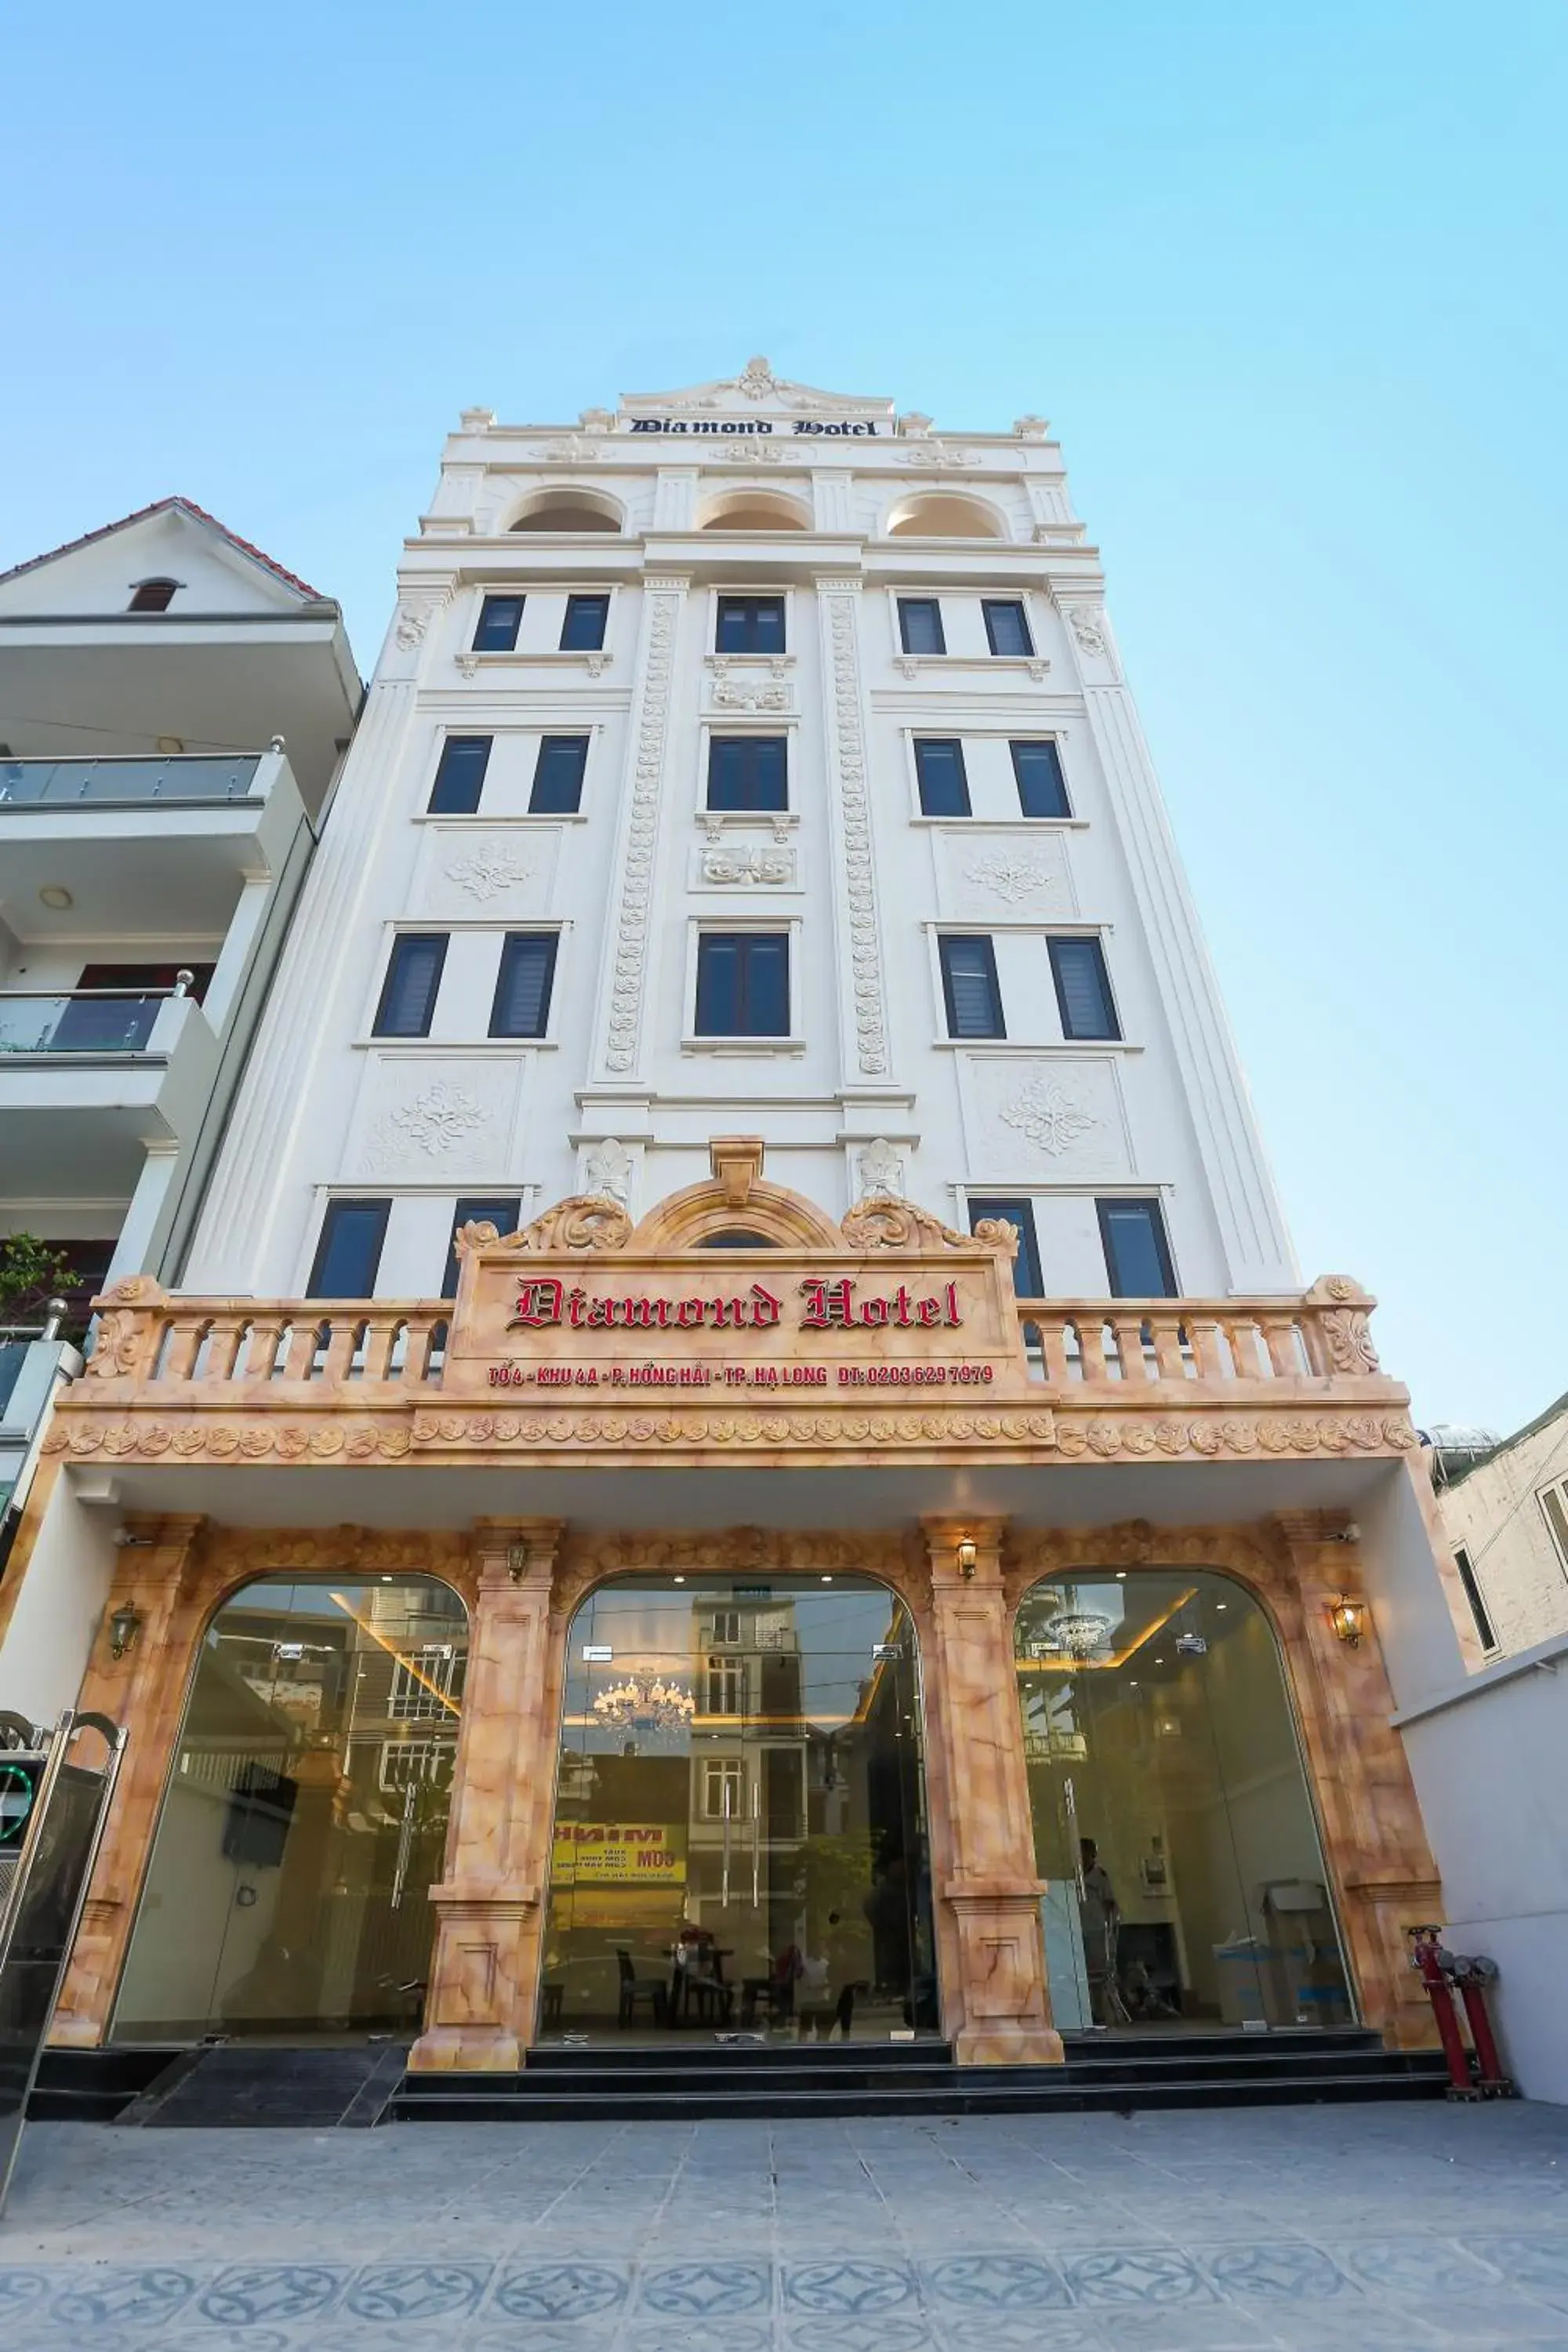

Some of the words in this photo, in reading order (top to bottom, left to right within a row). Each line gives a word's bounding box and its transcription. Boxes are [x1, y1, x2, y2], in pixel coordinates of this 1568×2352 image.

[630, 418, 772, 434] Diamond
[792, 420, 880, 436] Hotel
[506, 1277, 782, 1330] Diamond
[794, 1279, 964, 1329] Hotel
[536, 1367, 573, 1385] KHU
[782, 1367, 828, 1386] LONG
